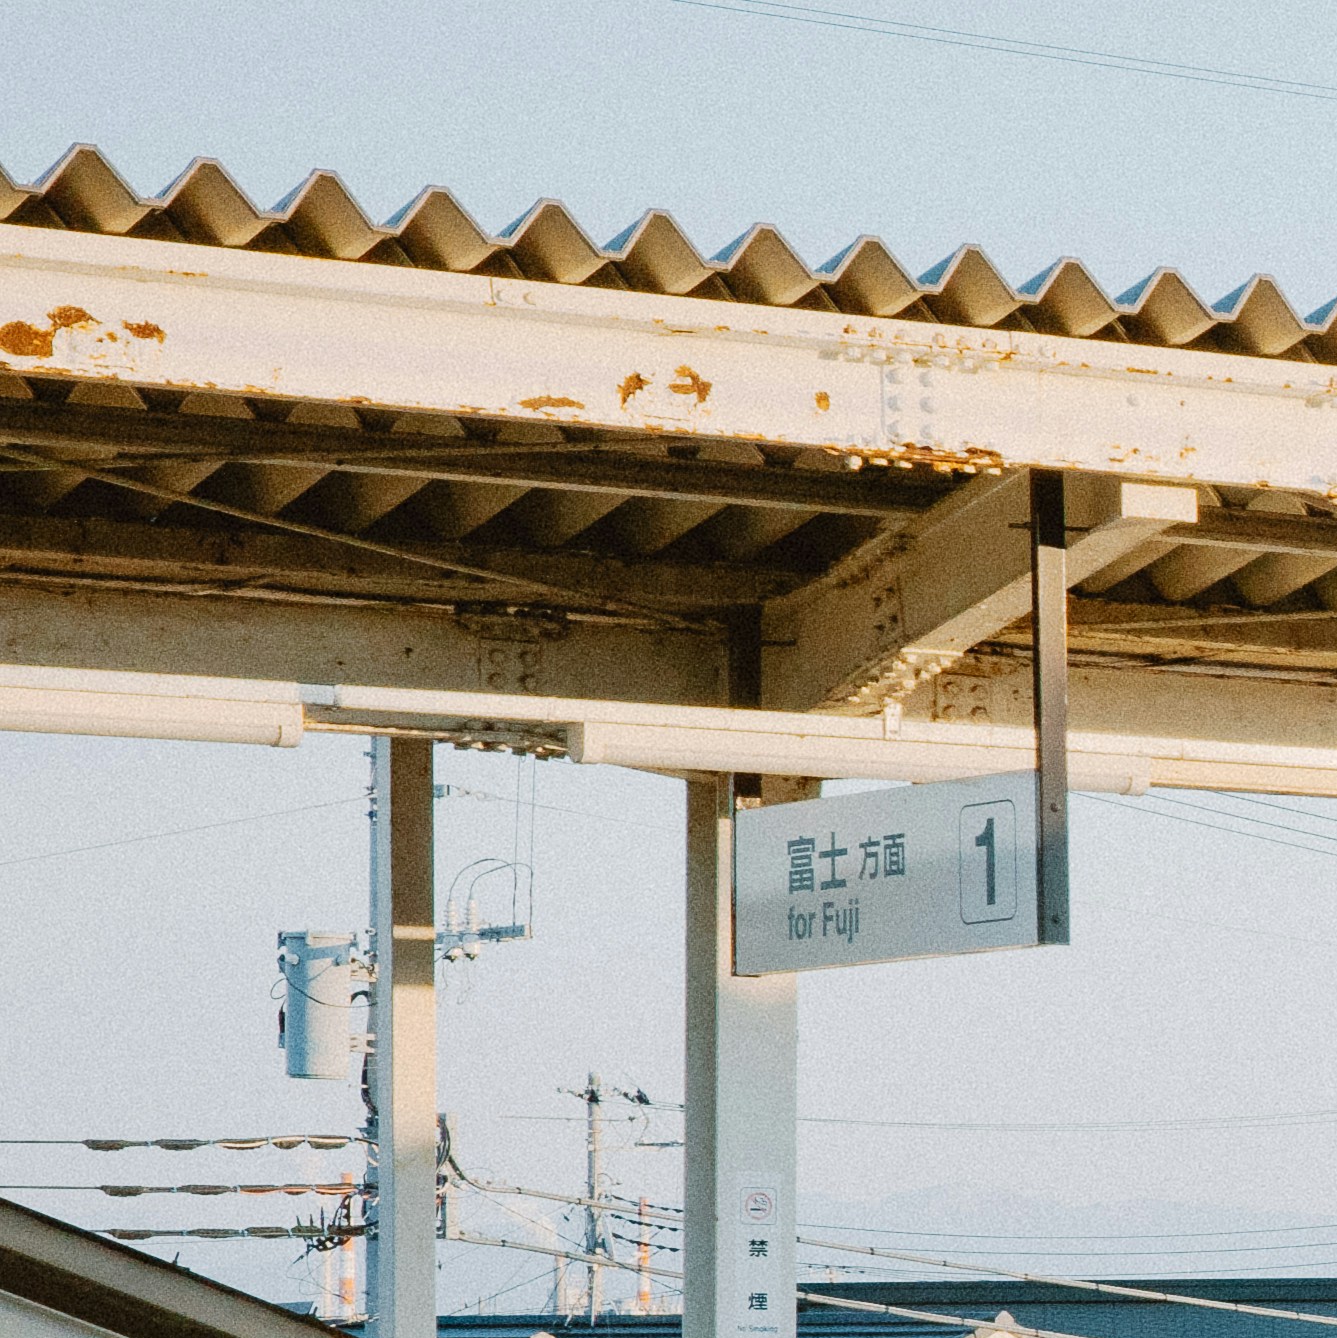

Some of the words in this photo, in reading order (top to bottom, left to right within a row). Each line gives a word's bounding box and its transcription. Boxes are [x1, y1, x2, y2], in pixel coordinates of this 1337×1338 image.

[786, 831, 848, 894] 富士
[858, 832, 906, 881] 方面
[975, 817, 996, 905] 1
[787, 903, 817, 941] for
[822, 898, 861, 944] Fuji
[749, 1239, 768, 1310] 禁煙
